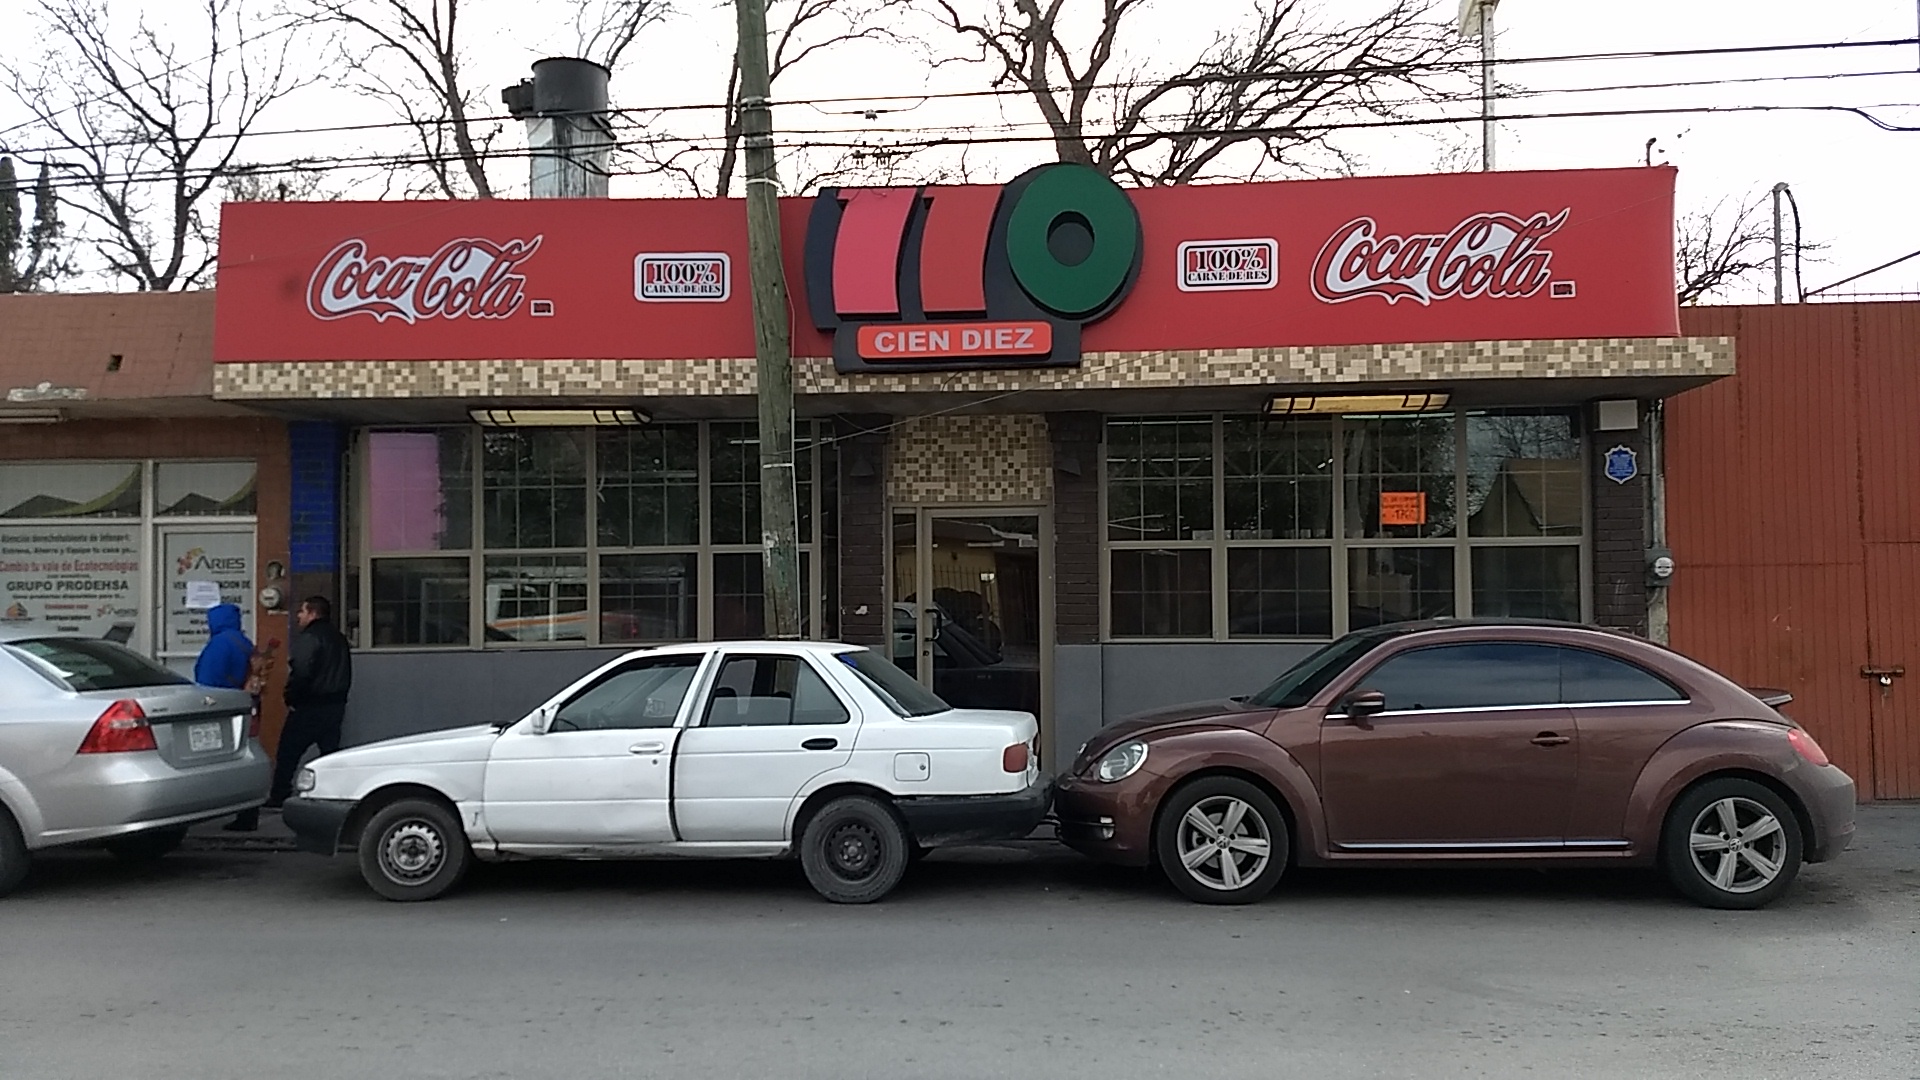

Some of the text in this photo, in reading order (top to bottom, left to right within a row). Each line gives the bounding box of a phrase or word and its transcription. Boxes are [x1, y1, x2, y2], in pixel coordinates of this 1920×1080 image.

[1198, 248, 1261, 270] 100%
[1311, 207, 1571, 305] Coca-Cola
[307, 236, 543, 324] Coca-Cola
[655, 263, 715, 282] 100%
[1187, 270, 1268, 282] CARNE DE RES
[645, 284, 721, 293] CARNE DE RES
[874, 327, 1034, 353] CIEN DIEZ
[195, 555, 246, 570] ARIES
[6, 580, 129, 592] GRUPO PRODEHSA
